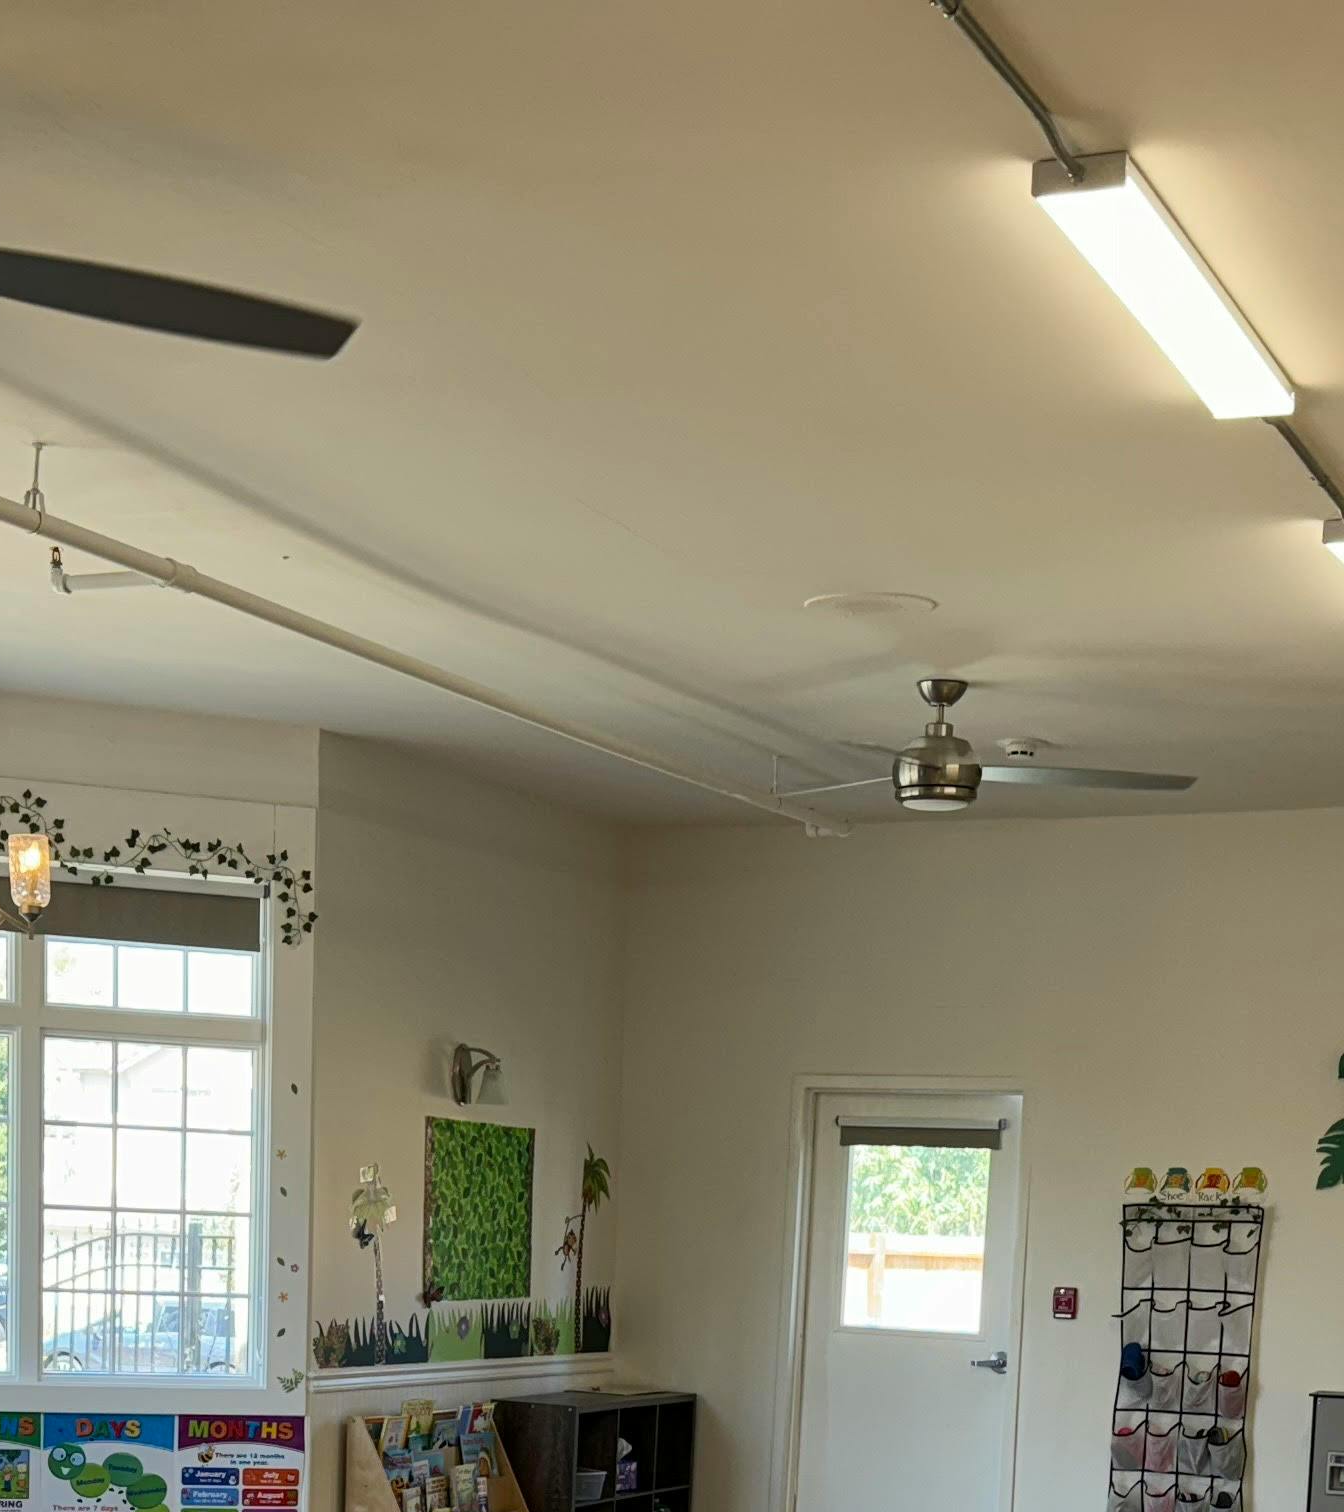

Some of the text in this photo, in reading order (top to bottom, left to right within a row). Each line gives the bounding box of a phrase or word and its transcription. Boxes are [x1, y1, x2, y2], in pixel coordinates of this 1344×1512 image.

[75, 1418, 142, 1439] DAYS
[187, 1419, 295, 1441] MONTHS
[195, 1470, 227, 1479] January
[263, 1471, 280, 1480] July
[192, 1490, 228, 1499] February
[256, 1491, 285, 1500] August
